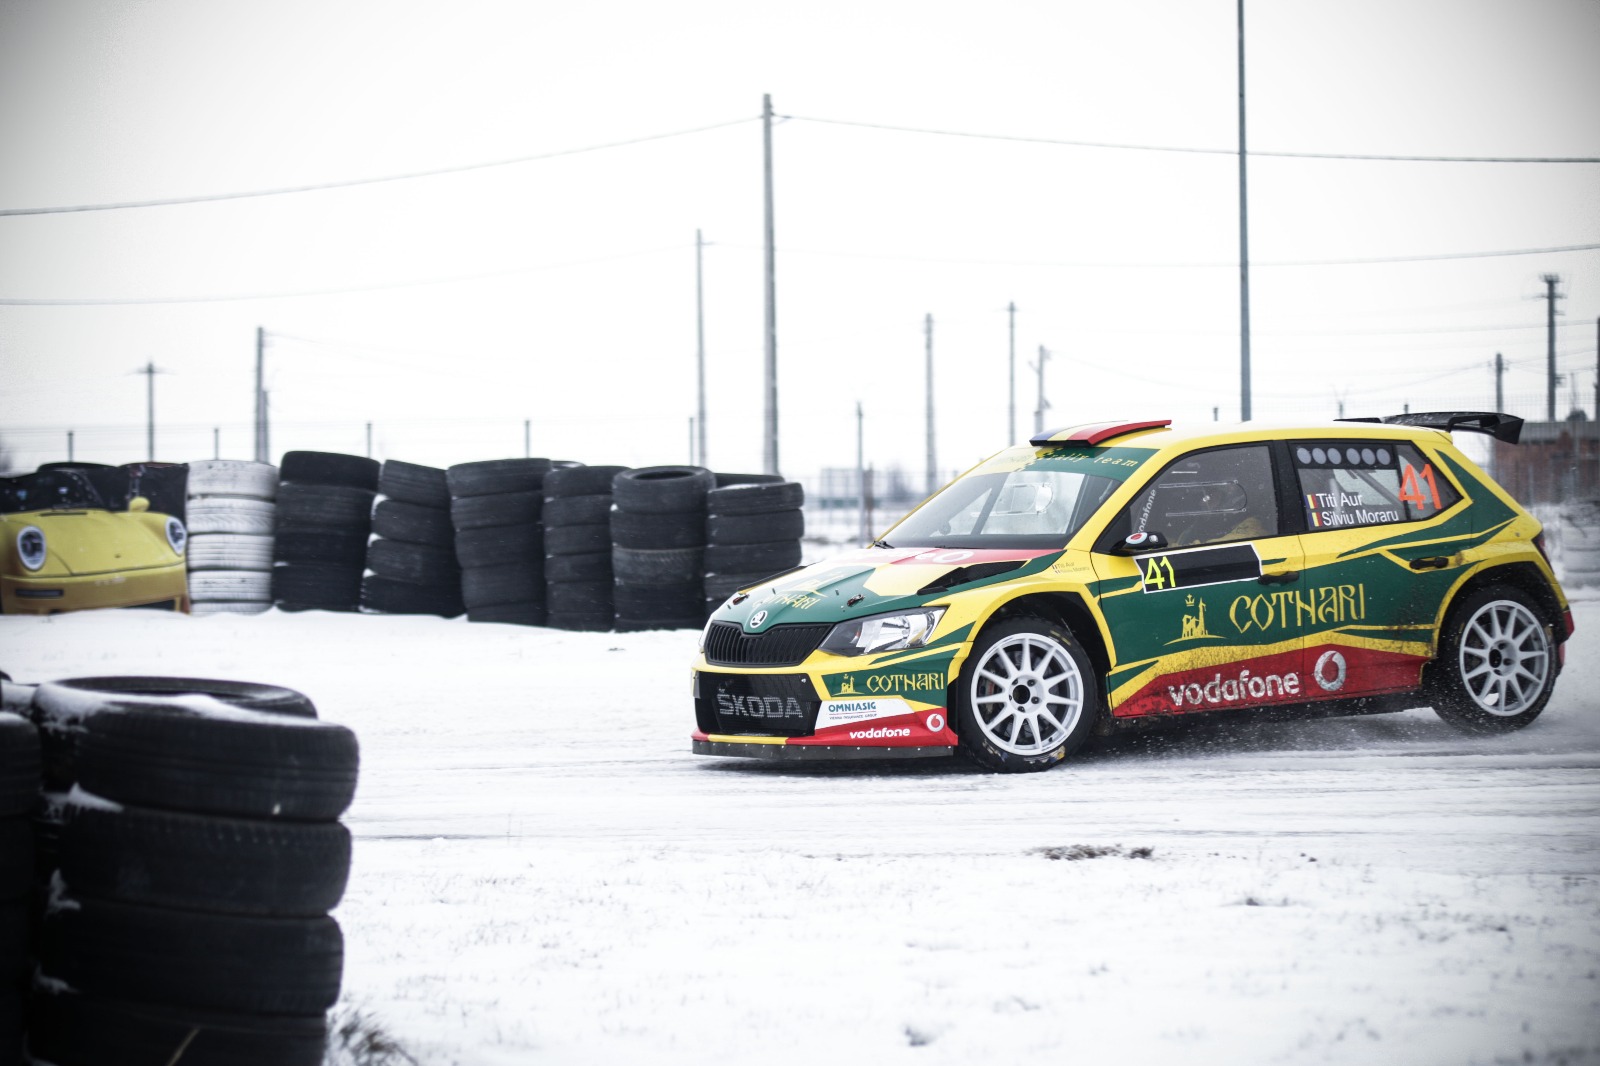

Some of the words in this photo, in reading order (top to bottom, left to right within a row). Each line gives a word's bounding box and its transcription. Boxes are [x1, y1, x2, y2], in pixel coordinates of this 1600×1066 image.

[1093, 456, 1139, 467] team
[1398, 463, 1443, 511] 41
[1137, 489, 1156, 533] odafone
[1315, 493, 1338, 508] Titi
[1339, 492, 1363, 507] Aur
[1321, 510, 1355, 526] Silviu
[1356, 509, 1399, 524] Moraru
[1144, 555, 1177, 590] 41
[1228, 583, 1365, 633] COTNARI
[866, 672, 946, 693] COTNARI
[1167, 669, 1300, 707] vodafone
[716, 688, 804, 718] ŠKODA
[828, 701, 877, 712] OMNIASIG
[849, 726, 911, 740] vodafone
